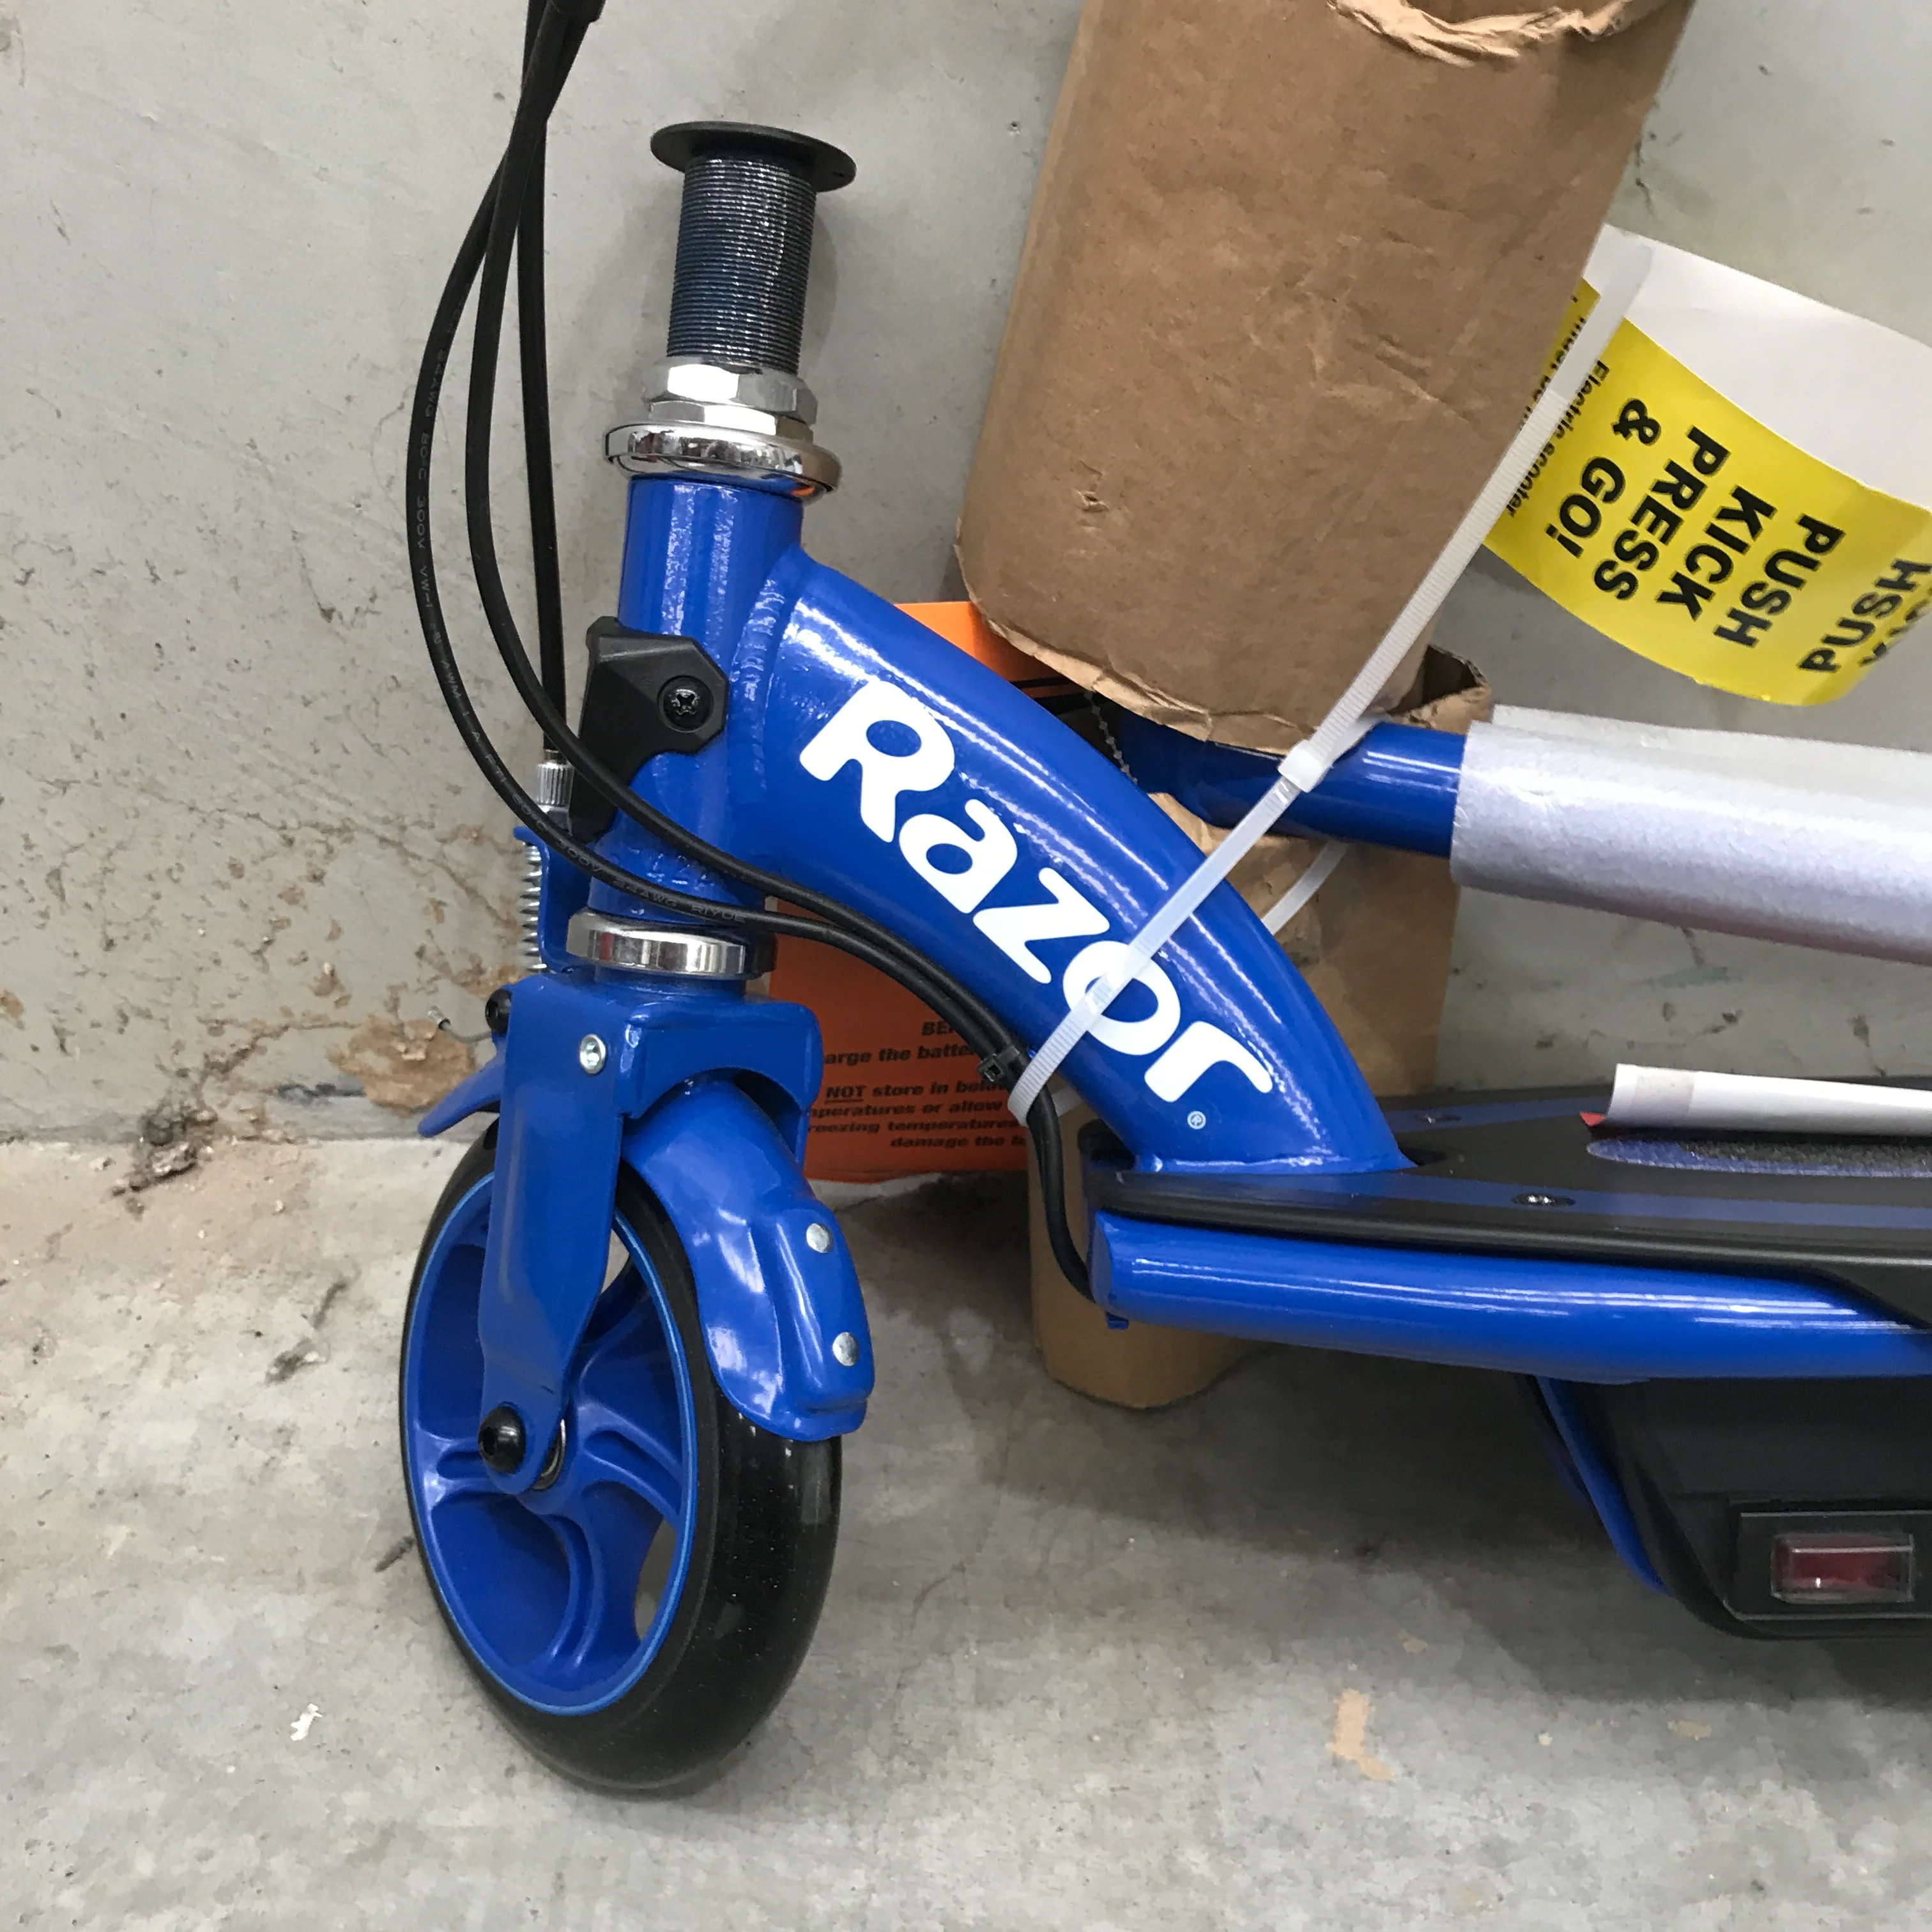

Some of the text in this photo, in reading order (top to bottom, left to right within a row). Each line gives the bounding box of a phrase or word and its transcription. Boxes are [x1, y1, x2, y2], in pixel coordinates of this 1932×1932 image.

[415, 495, 426, 550] 300V
[1506, 442, 1555, 517] scooter
[1545, 398, 1661, 558] & GO!
[1594, 425, 1731, 600] PRESS
[1656, 485, 1778, 621] KICK
[1715, 514, 1846, 647] PUSH
[1797, 557, 1932, 673] PUSH
[799, 680, 1273, 1103] Razor
[826, 1085, 866, 1098] NOT
[873, 1084, 924, 1096] store
[930, 1082, 949, 1094] in
[879, 1048, 910, 1062] the
[917, 1043, 974, 1059] batte
[890, 1137, 970, 1148] damage
[975, 1135, 1005, 1146] the
[922, 1104, 943, 1114] or
[949, 1100, 1003, 1113] allow
